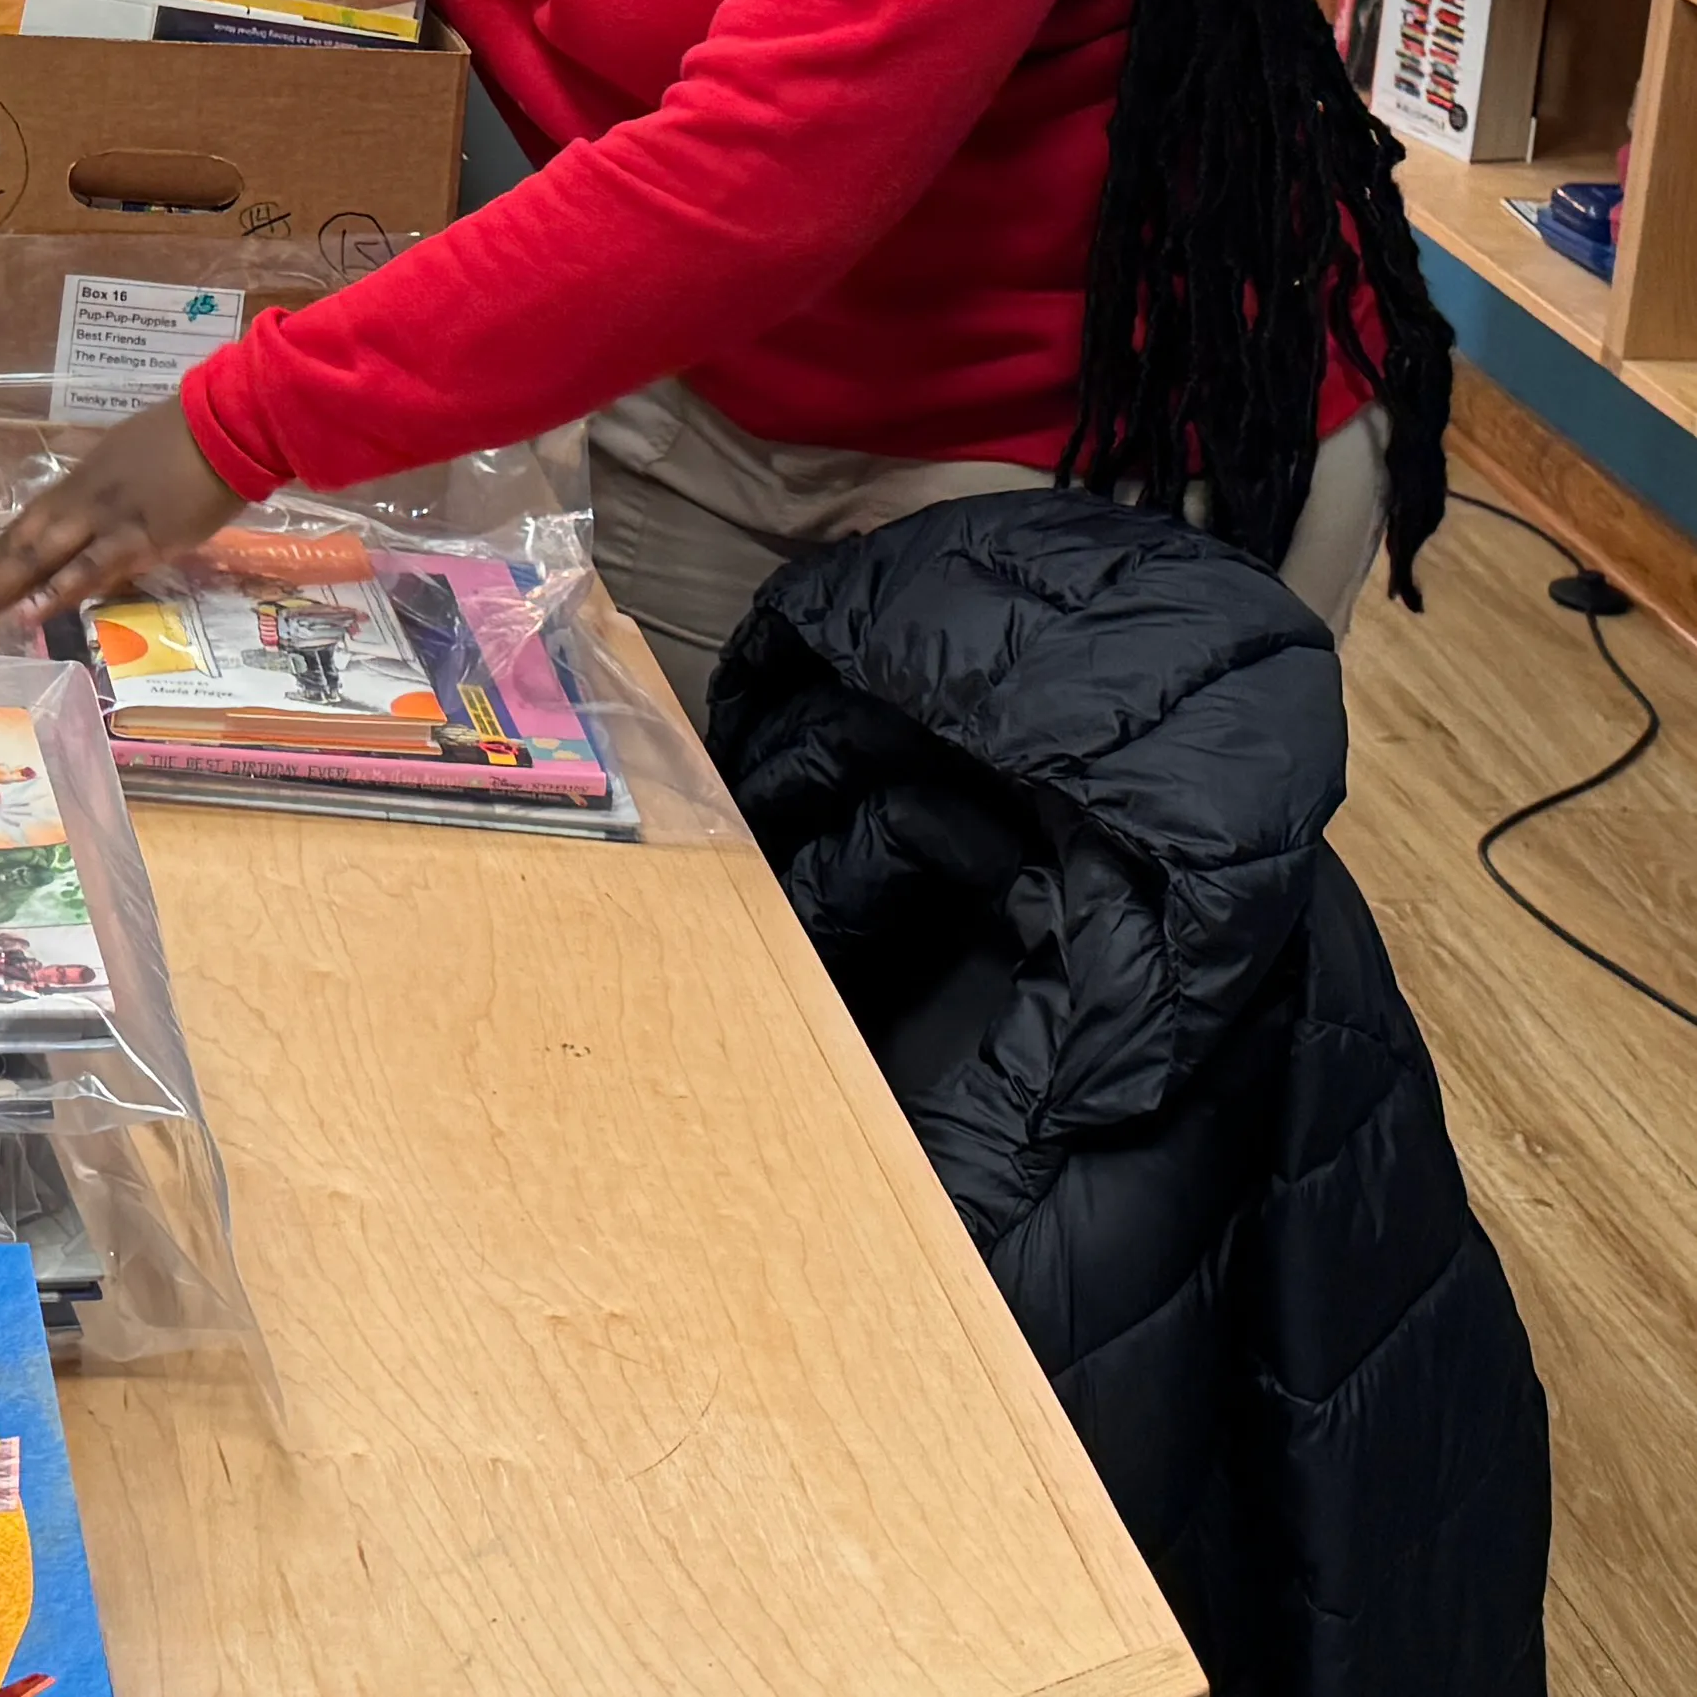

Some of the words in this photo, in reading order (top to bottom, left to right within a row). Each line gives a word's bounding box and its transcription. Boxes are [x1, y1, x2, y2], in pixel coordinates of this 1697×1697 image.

[82, 286, 108, 301] Box
[113, 289, 128, 302] 16
[79, 308, 177, 328] Pup-Pup-Puppies
[76, 329, 102, 341] Best
[105, 331, 147, 346] Friends
[75, 350, 96, 362] The
[99, 352, 147, 368] Feelings
[149, 357, 178, 369] Book
[70, 392, 107, 409] Twinky
[110, 394, 128, 408] the
[150, 753, 182, 768] THE
[189, 756, 229, 773] BEST
[232, 760, 300, 777] BIRTHDAY
